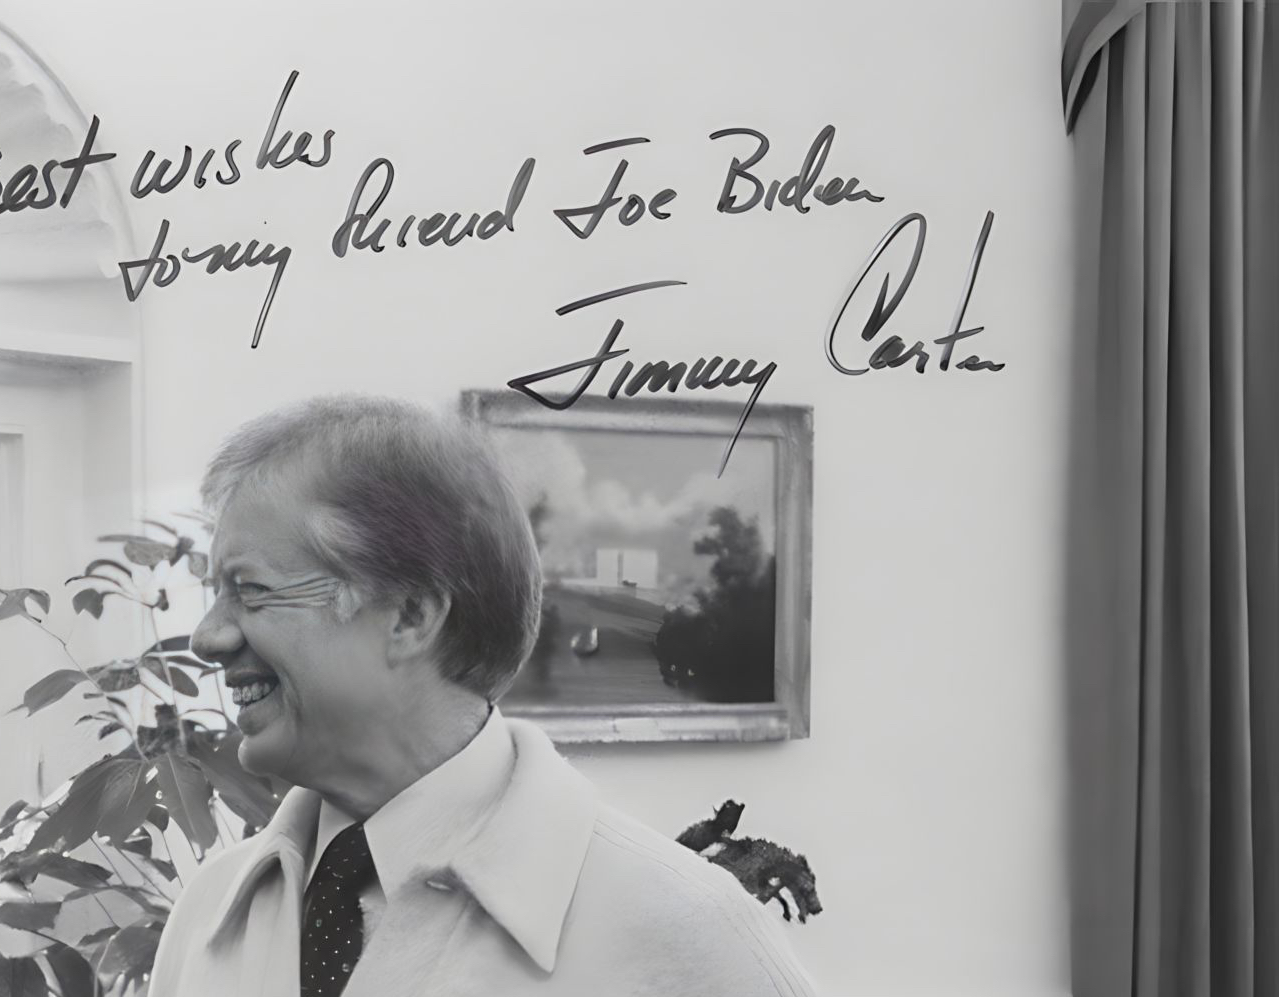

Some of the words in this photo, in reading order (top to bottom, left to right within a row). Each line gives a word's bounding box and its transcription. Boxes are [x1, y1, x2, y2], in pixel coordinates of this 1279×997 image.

[130, 70, 336, 200] wishes
[331, 156, 536, 259] friend
[553, 137, 678, 240] Joe
[709, 124, 885, 215] Biden
[507, 280, 777, 479] Jimmy
[824, 210, 1006, 376] Carter
